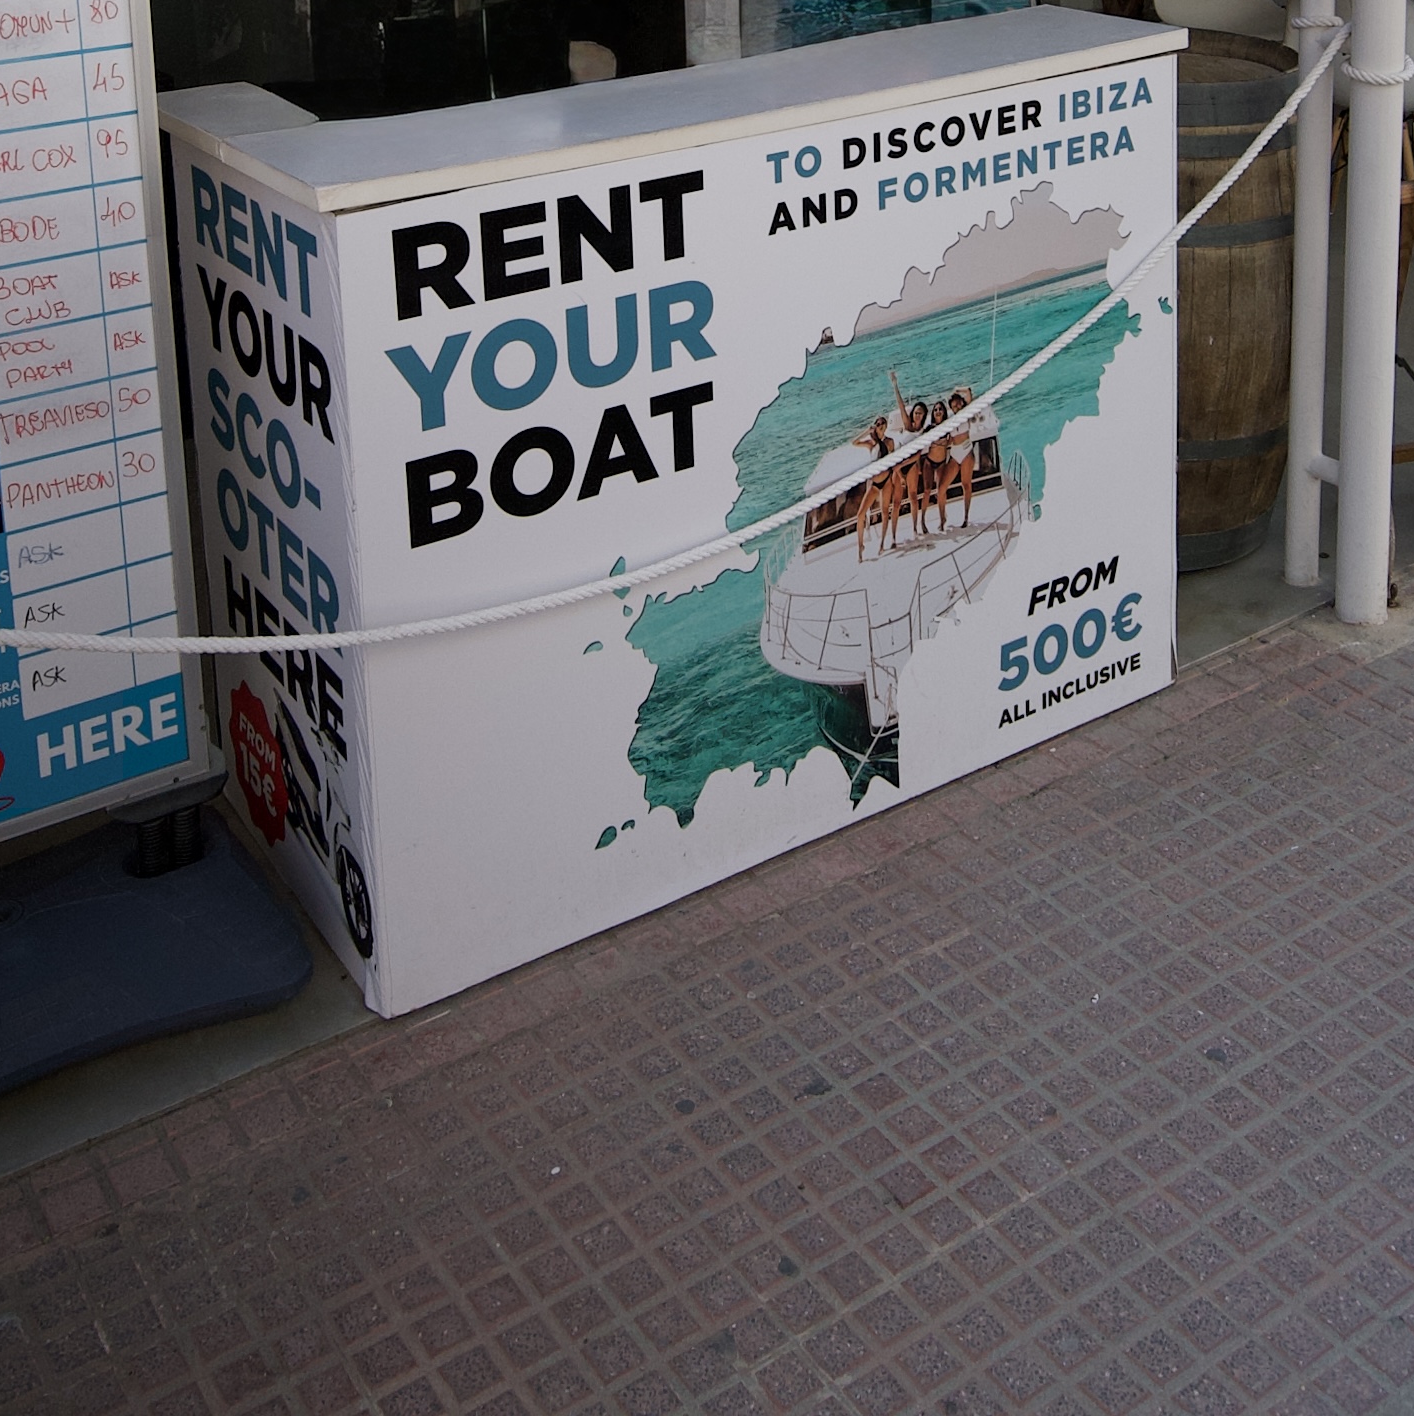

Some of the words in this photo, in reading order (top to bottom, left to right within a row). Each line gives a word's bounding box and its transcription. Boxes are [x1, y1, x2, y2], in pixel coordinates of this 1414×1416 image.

[93, 63, 125, 94] 45
[32, 145, 77, 172] COX
[97, 129, 128, 158] 95
[766, 144, 822, 185] TO
[842, 99, 1042, 170] DISCOVER
[1059, 76, 1153, 123] IBIZA
[101, 197, 136, 227] 40
[768, 187, 859, 237] AND
[877, 125, 1135, 211] FORMENTERA
[192, 164, 318, 319] RENT
[391, 169, 704, 321] RENT
[109, 271, 142, 290] ASK
[6, 359, 73, 388] PARTY
[113, 331, 146, 351] ASK
[196, 264, 335, 444] YOUR
[384, 280, 717, 432] YOUR
[119, 387, 151, 413] 50
[209, 366, 321, 511] SCO-
[7, 470, 115, 509] PANTHEON
[123, 451, 155, 478] 30
[405, 382, 714, 549] BOAT
[18, 543, 64, 568] ASK
[216, 467, 344, 659] OTER
[1027, 555, 1119, 616] FROM
[24, 602, 65, 629] ASK
[998, 592, 1143, 692] 500€
[33, 666, 67, 691] ASK
[223, 554, 348, 763] HERE
[998, 698, 1036, 729] ALL
[1041, 652, 1141, 711] INCLUSIVE
[36, 691, 180, 779] HERE
[239, 712, 277, 772] FROM
[239, 741, 277, 818] 15€
